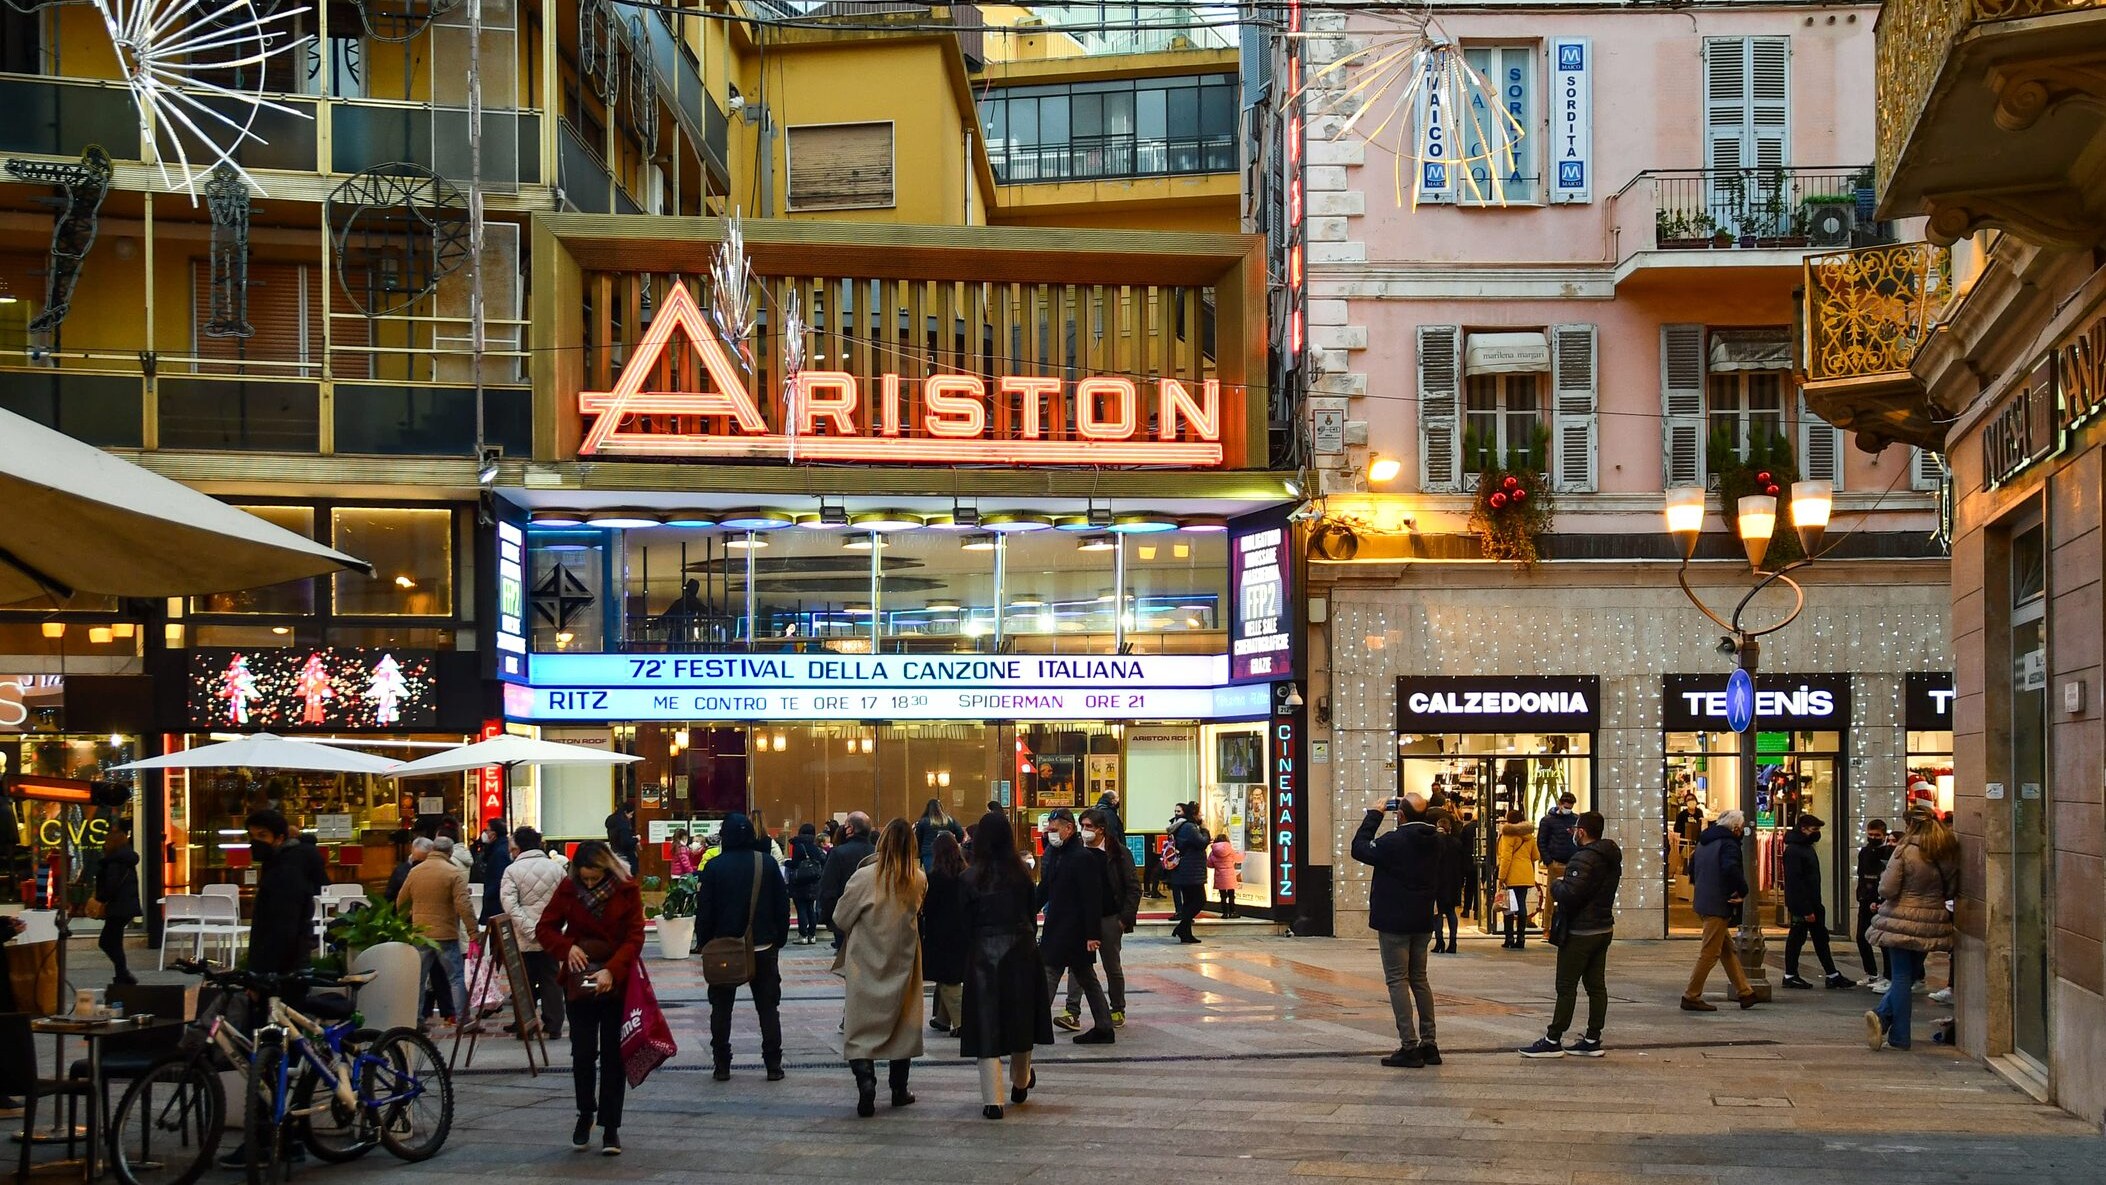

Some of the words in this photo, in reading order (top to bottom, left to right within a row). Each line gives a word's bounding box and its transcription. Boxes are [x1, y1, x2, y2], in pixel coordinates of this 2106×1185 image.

[578, 279, 1220, 456] ARISTON
[1483, 350, 1514, 359] marilena
[1245, 582, 1276, 620] FFP2
[674, 659, 795, 679] FESTIVAL
[808, 661, 888, 679] DELLA
[903, 661, 1020, 680] CANZONE
[1038, 660, 1145, 679] ITALIANA
[549, 691, 608, 710] RITZ
[654, 696, 679, 710] ME
[694, 696, 767, 711] CONTRO
[780, 697, 799, 710] TE
[814, 696, 849, 710] ORE
[861, 696, 878, 710] 17
[959, 695, 1063, 708] SPIDERMAN
[1085, 695, 1121, 709] ORE
[1129, 695, 1145, 708] 21
[1408, 692, 1589, 714] CALZEDONIA
[485, 727, 499, 807] CEMA
[1277, 724, 1292, 824] CINEMA
[1278, 831, 1293, 896] RITZ
